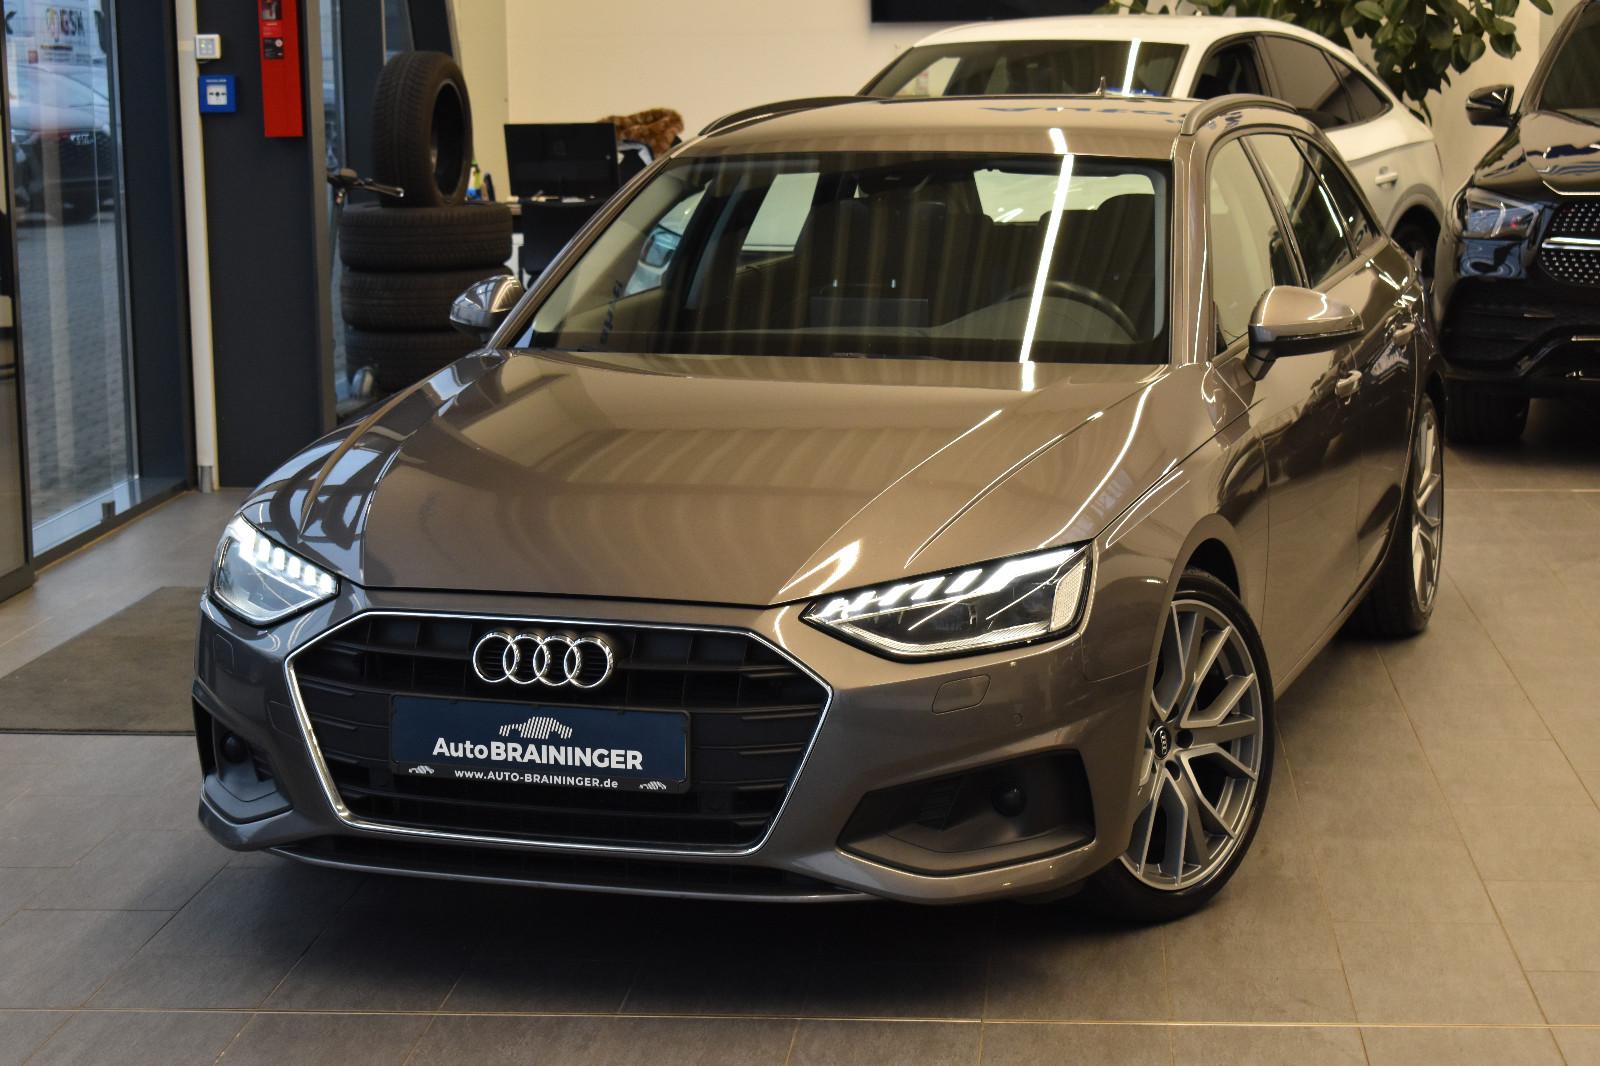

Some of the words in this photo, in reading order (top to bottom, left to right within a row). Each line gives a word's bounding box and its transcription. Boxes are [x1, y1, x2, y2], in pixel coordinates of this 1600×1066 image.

[432, 737, 488, 760] Auto
[490, 741, 643, 770] BRAININGER
[454, 769, 618, 789] www.AUTO-BRAININGER.de
